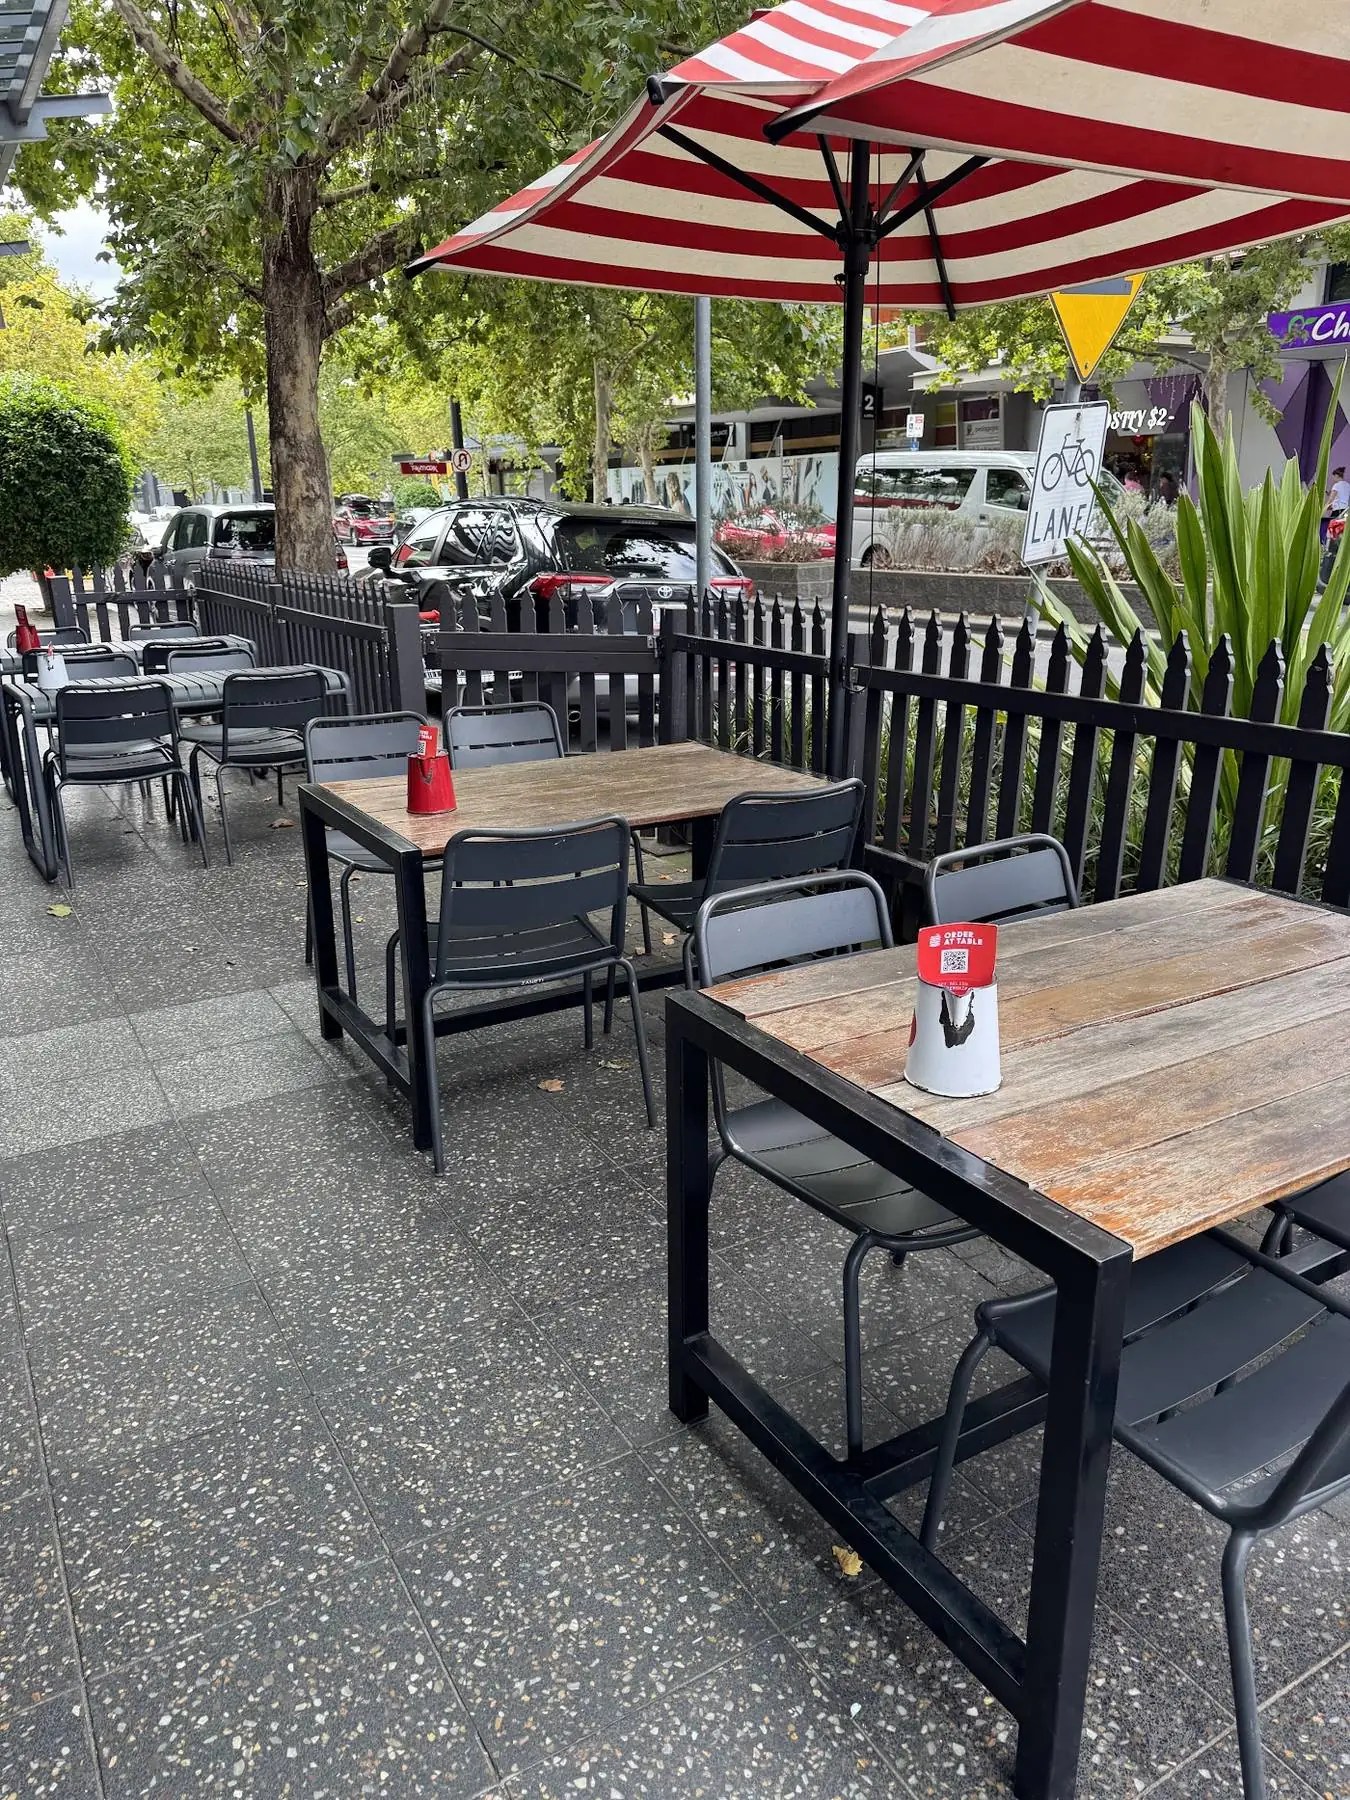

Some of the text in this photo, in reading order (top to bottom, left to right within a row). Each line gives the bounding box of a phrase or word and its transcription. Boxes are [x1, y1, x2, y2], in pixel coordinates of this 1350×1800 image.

[1311, 310, 1350, 341] Ch
[864, 394, 874, 411] 2
[1031, 503, 1087, 545] LANE
[943, 931, 974, 939] ORDER
